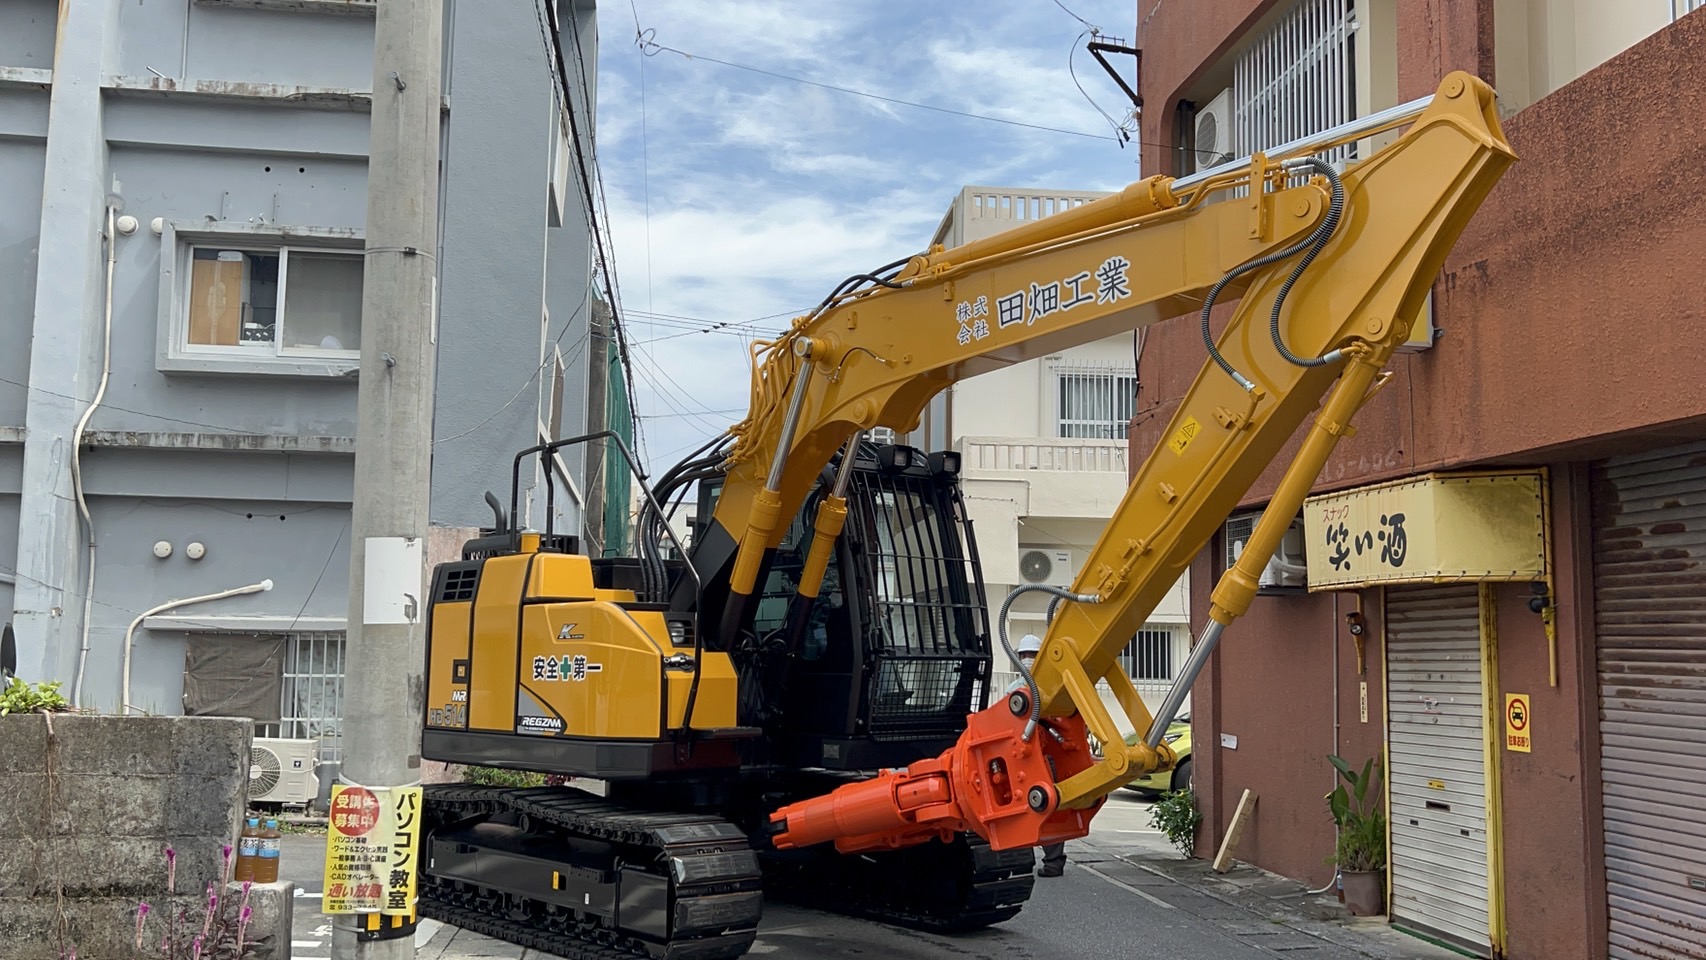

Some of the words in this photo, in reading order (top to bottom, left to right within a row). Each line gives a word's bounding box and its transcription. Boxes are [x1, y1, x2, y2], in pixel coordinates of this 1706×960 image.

[997, 258, 1130, 327] 田畑工業
[957, 297, 988, 322] 株式
[957, 321, 989, 344] 会社
[1322, 505, 1349, 522] スナック
[1326, 513, 1407, 571] 笑い酒
[1508, 735, 1529, 748] 駐車お断り
[335, 813, 374, 828] 募集中
[387, 793, 417, 910] パソコン教室
[327, 883, 384, 898] 通い放題
